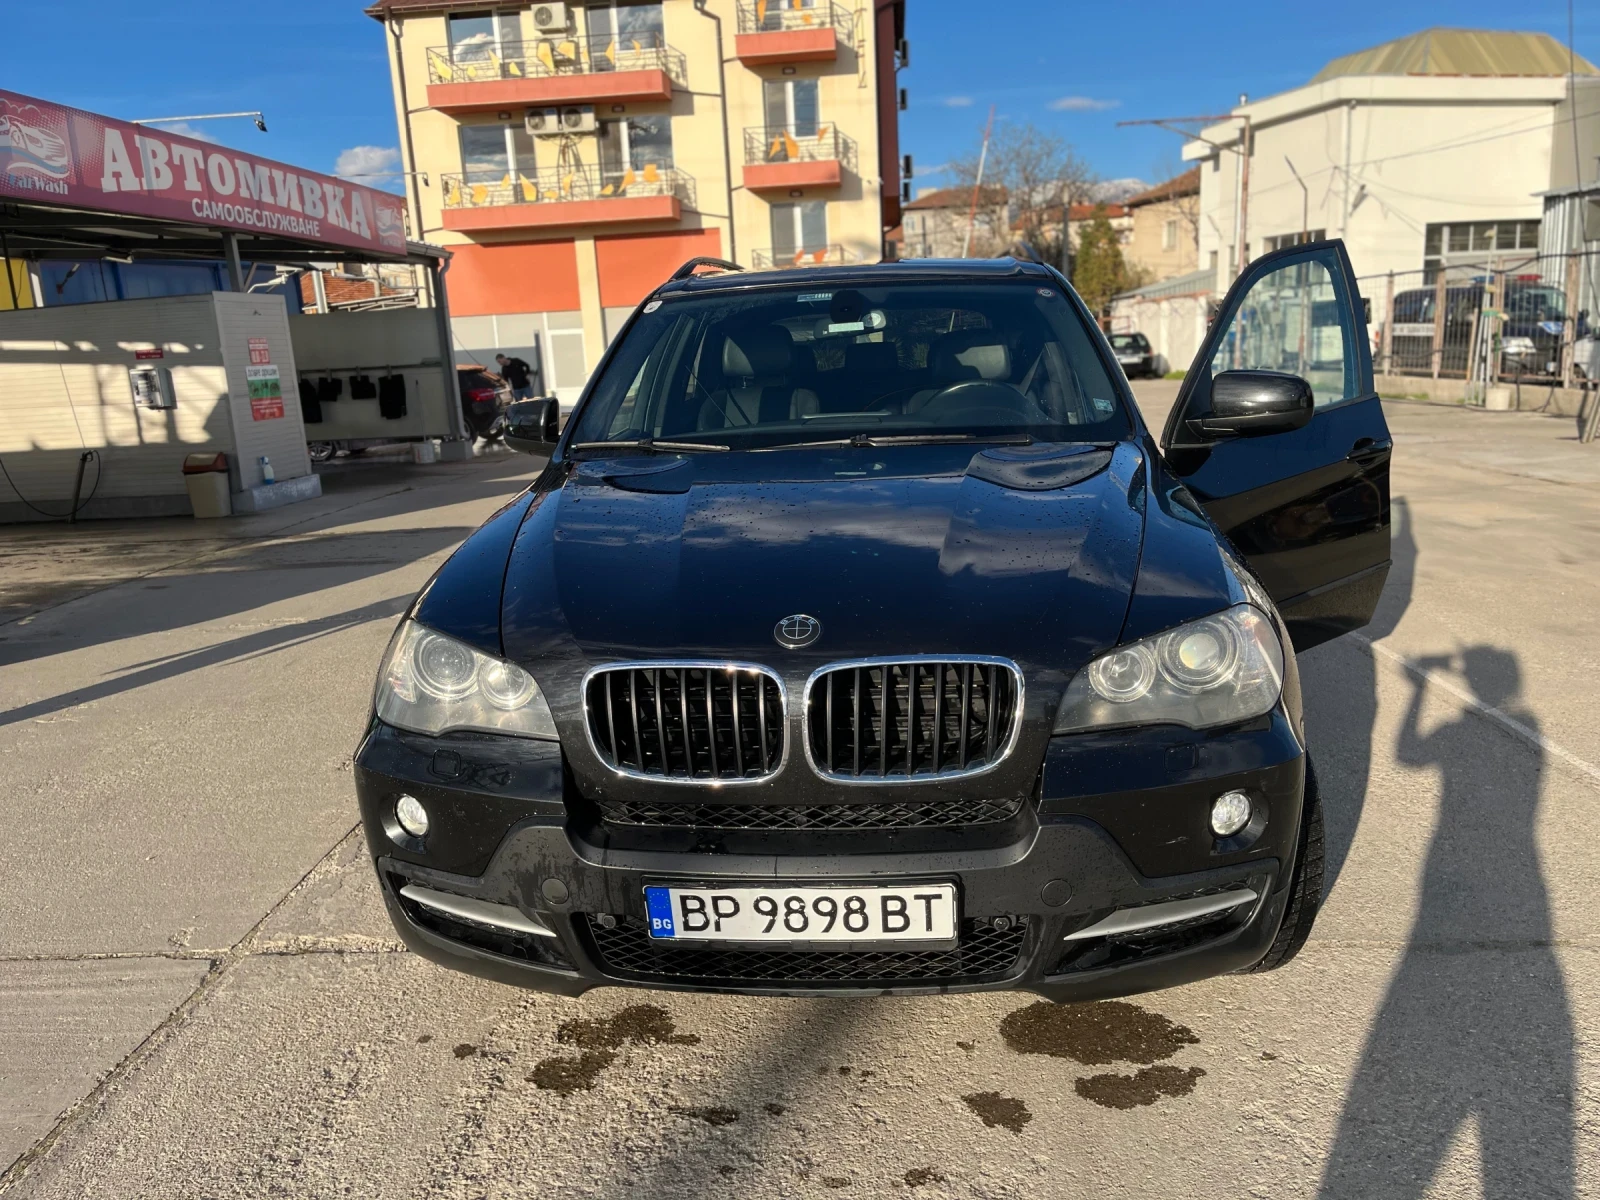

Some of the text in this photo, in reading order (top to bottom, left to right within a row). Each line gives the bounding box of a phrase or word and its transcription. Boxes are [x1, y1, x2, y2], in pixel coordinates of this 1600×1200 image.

[101, 127, 372, 240] АВТОМИВКА
[191, 197, 321, 237] САМООБСЛУЖВАНЕ
[652, 918, 673, 931] BG
[679, 893, 943, 933] BP 9898 BT
